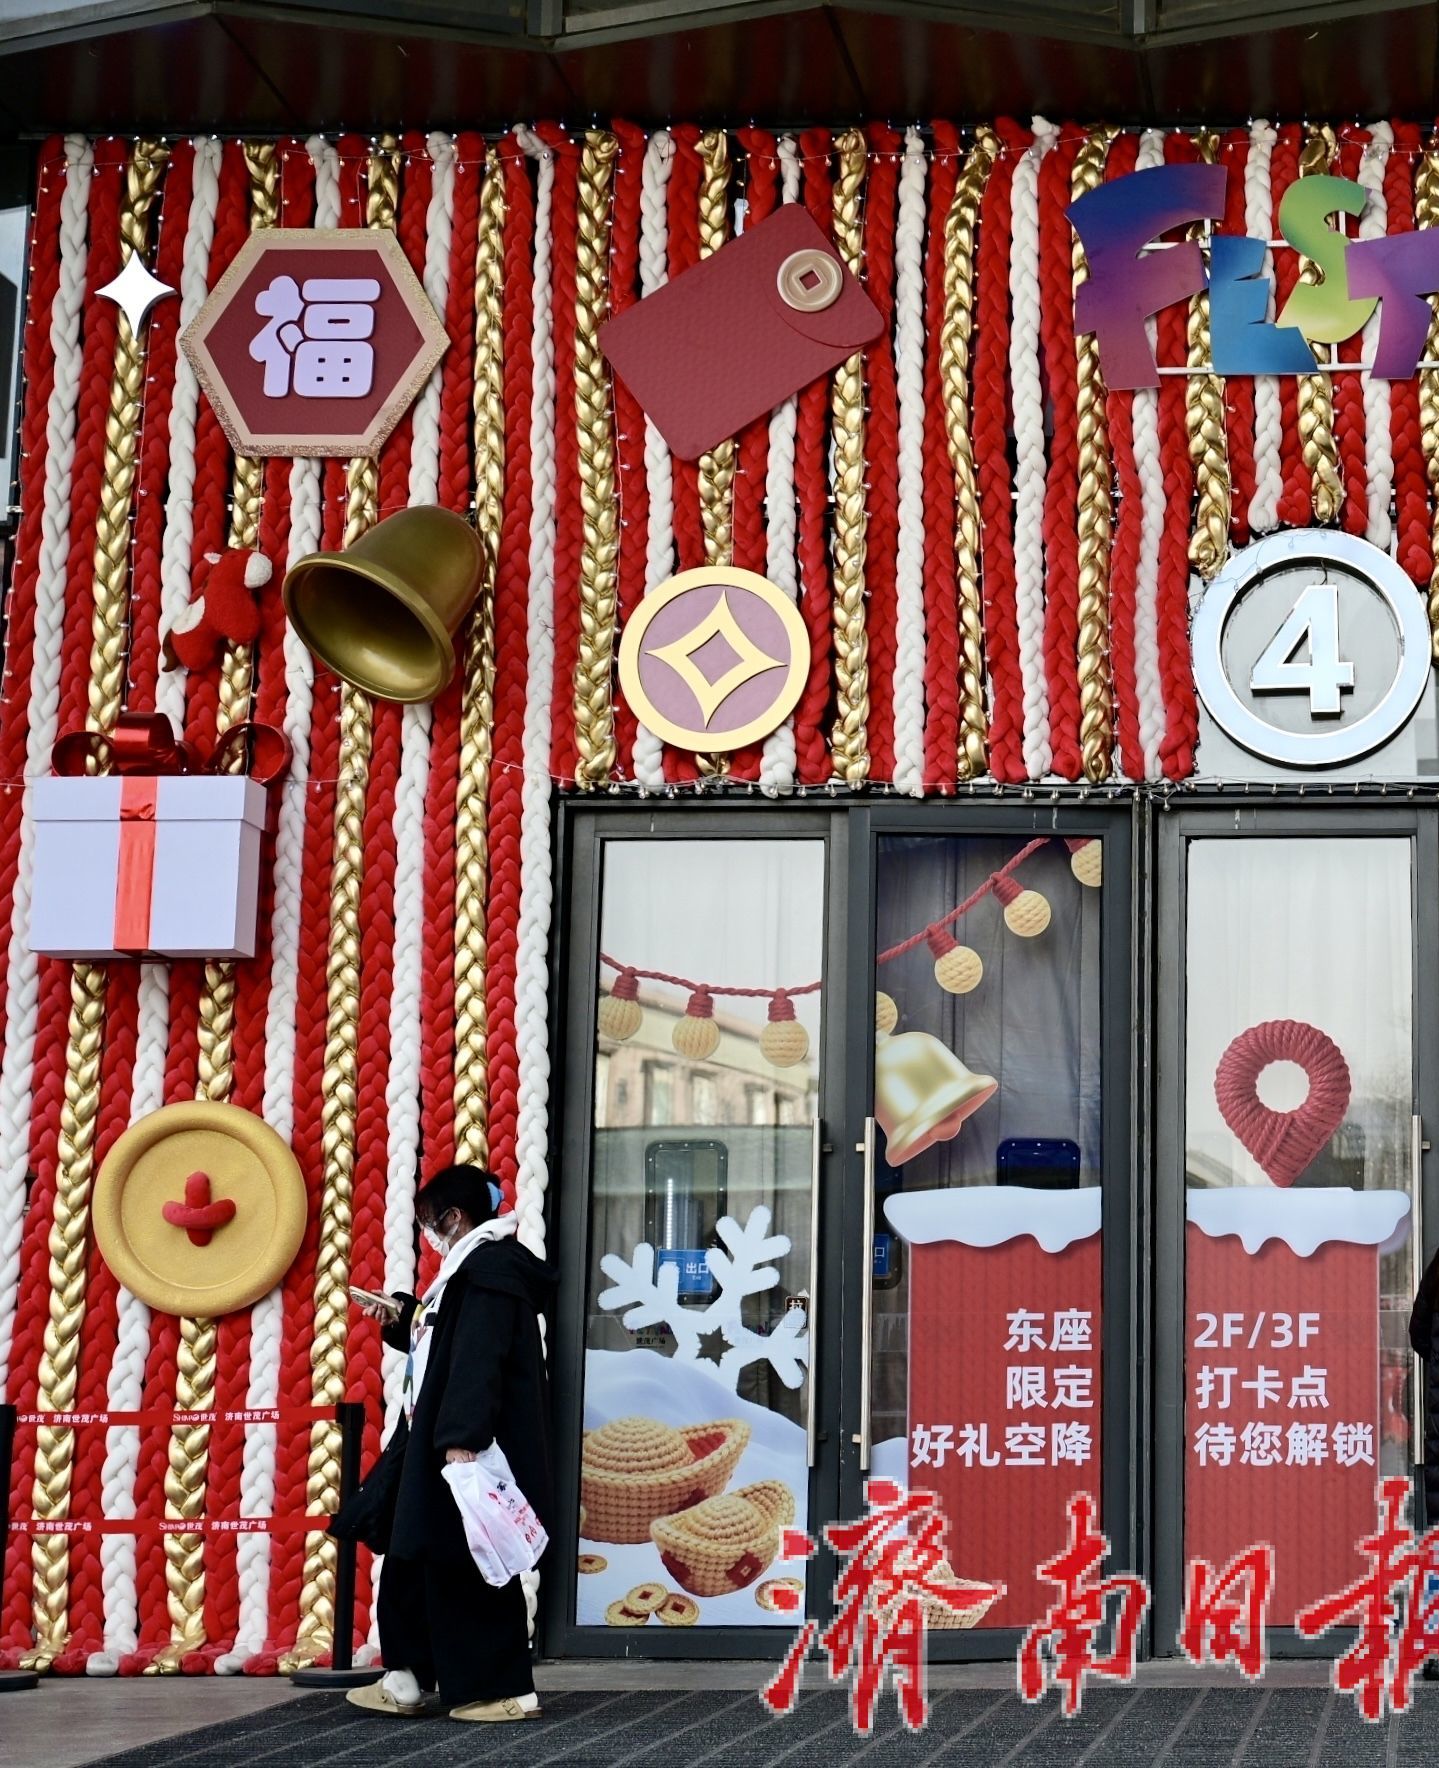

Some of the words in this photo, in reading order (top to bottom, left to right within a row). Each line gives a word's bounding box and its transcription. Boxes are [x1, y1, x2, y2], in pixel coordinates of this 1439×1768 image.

[248, 275, 382, 399] 福
[685, 1261, 709, 1274] 出口
[1003, 1308, 1094, 1353] 东座
[1194, 1310, 1321, 1351] 2F/3F
[1006, 1364, 1094, 1411] 限定
[1195, 1364, 1330, 1410] 打卡点
[53, 1413, 109, 1424] 济南世茂广场
[224, 1410, 280, 1421] 济南世茂广场
[910, 1422, 1094, 1469] 好礼空降
[1193, 1421, 1376, 1467] 待您解锁
[35, 1521, 93, 1532] 济南世茂广场
[211, 1520, 267, 1531] 济南世茂广场
